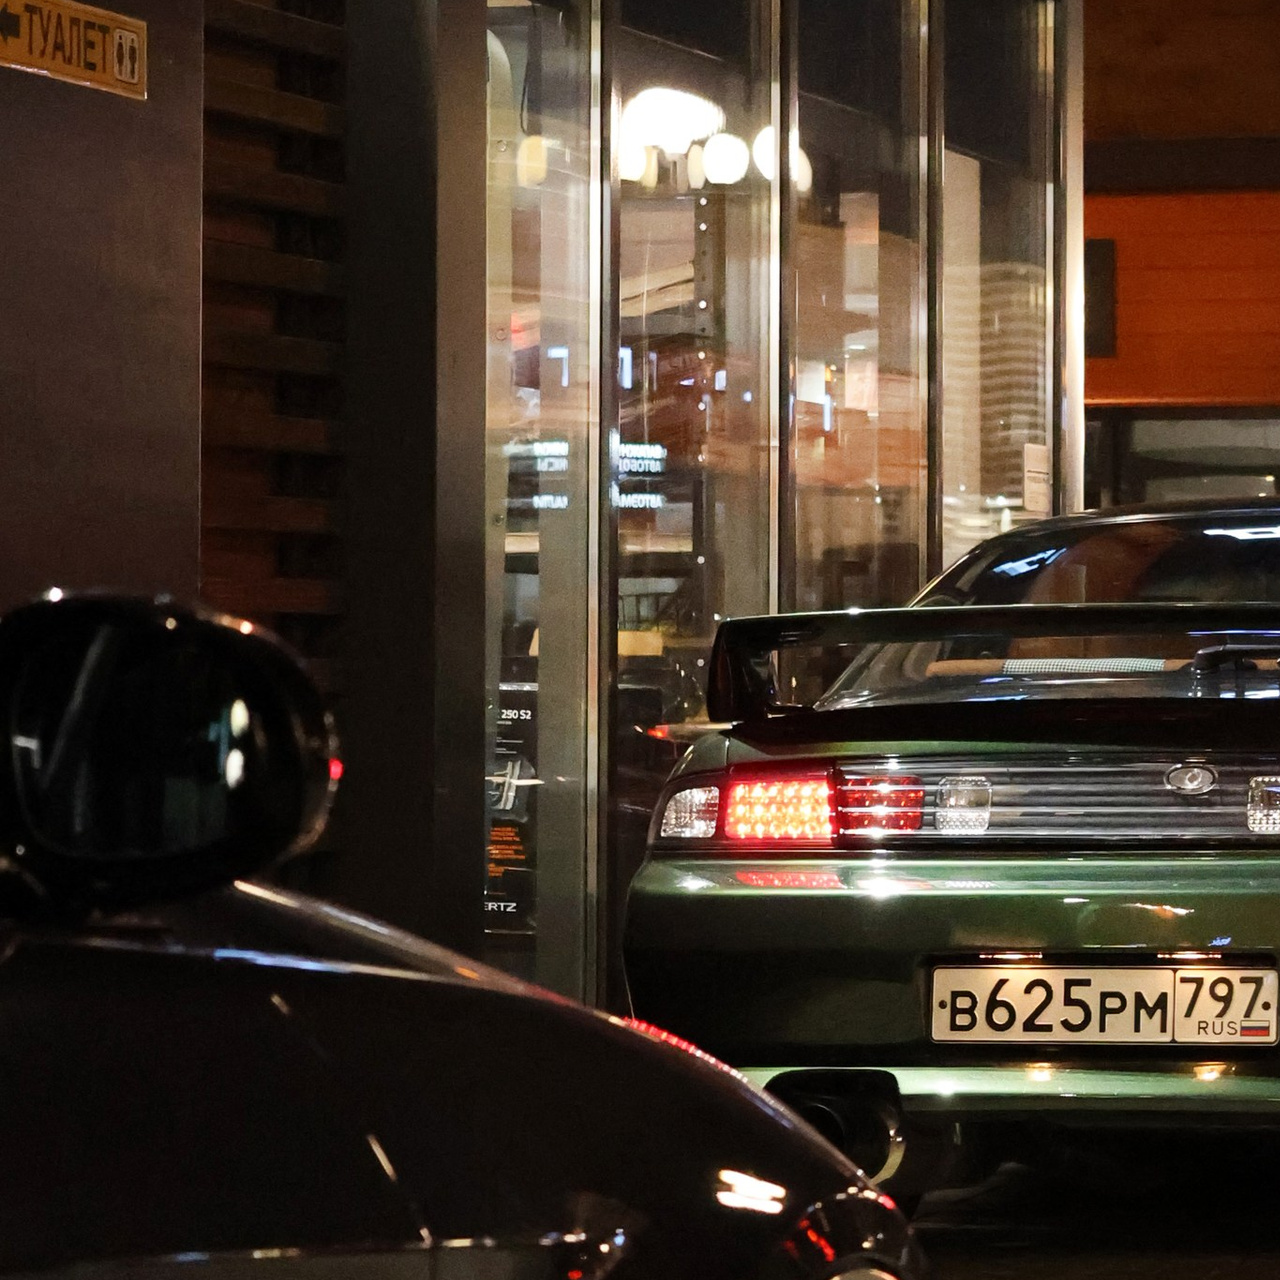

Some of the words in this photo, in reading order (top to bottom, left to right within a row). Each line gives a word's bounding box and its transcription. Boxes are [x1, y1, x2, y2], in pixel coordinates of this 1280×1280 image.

[24, 4, 110, 73] ТУАЛЕТ
[501, 710, 518, 719] 250
[520, 710, 531, 719] S2
[950, 978, 1168, 1032] В625РМ
[1180, 977, 1264, 1018] 797
[1197, 1021, 1237, 1036] RUS
